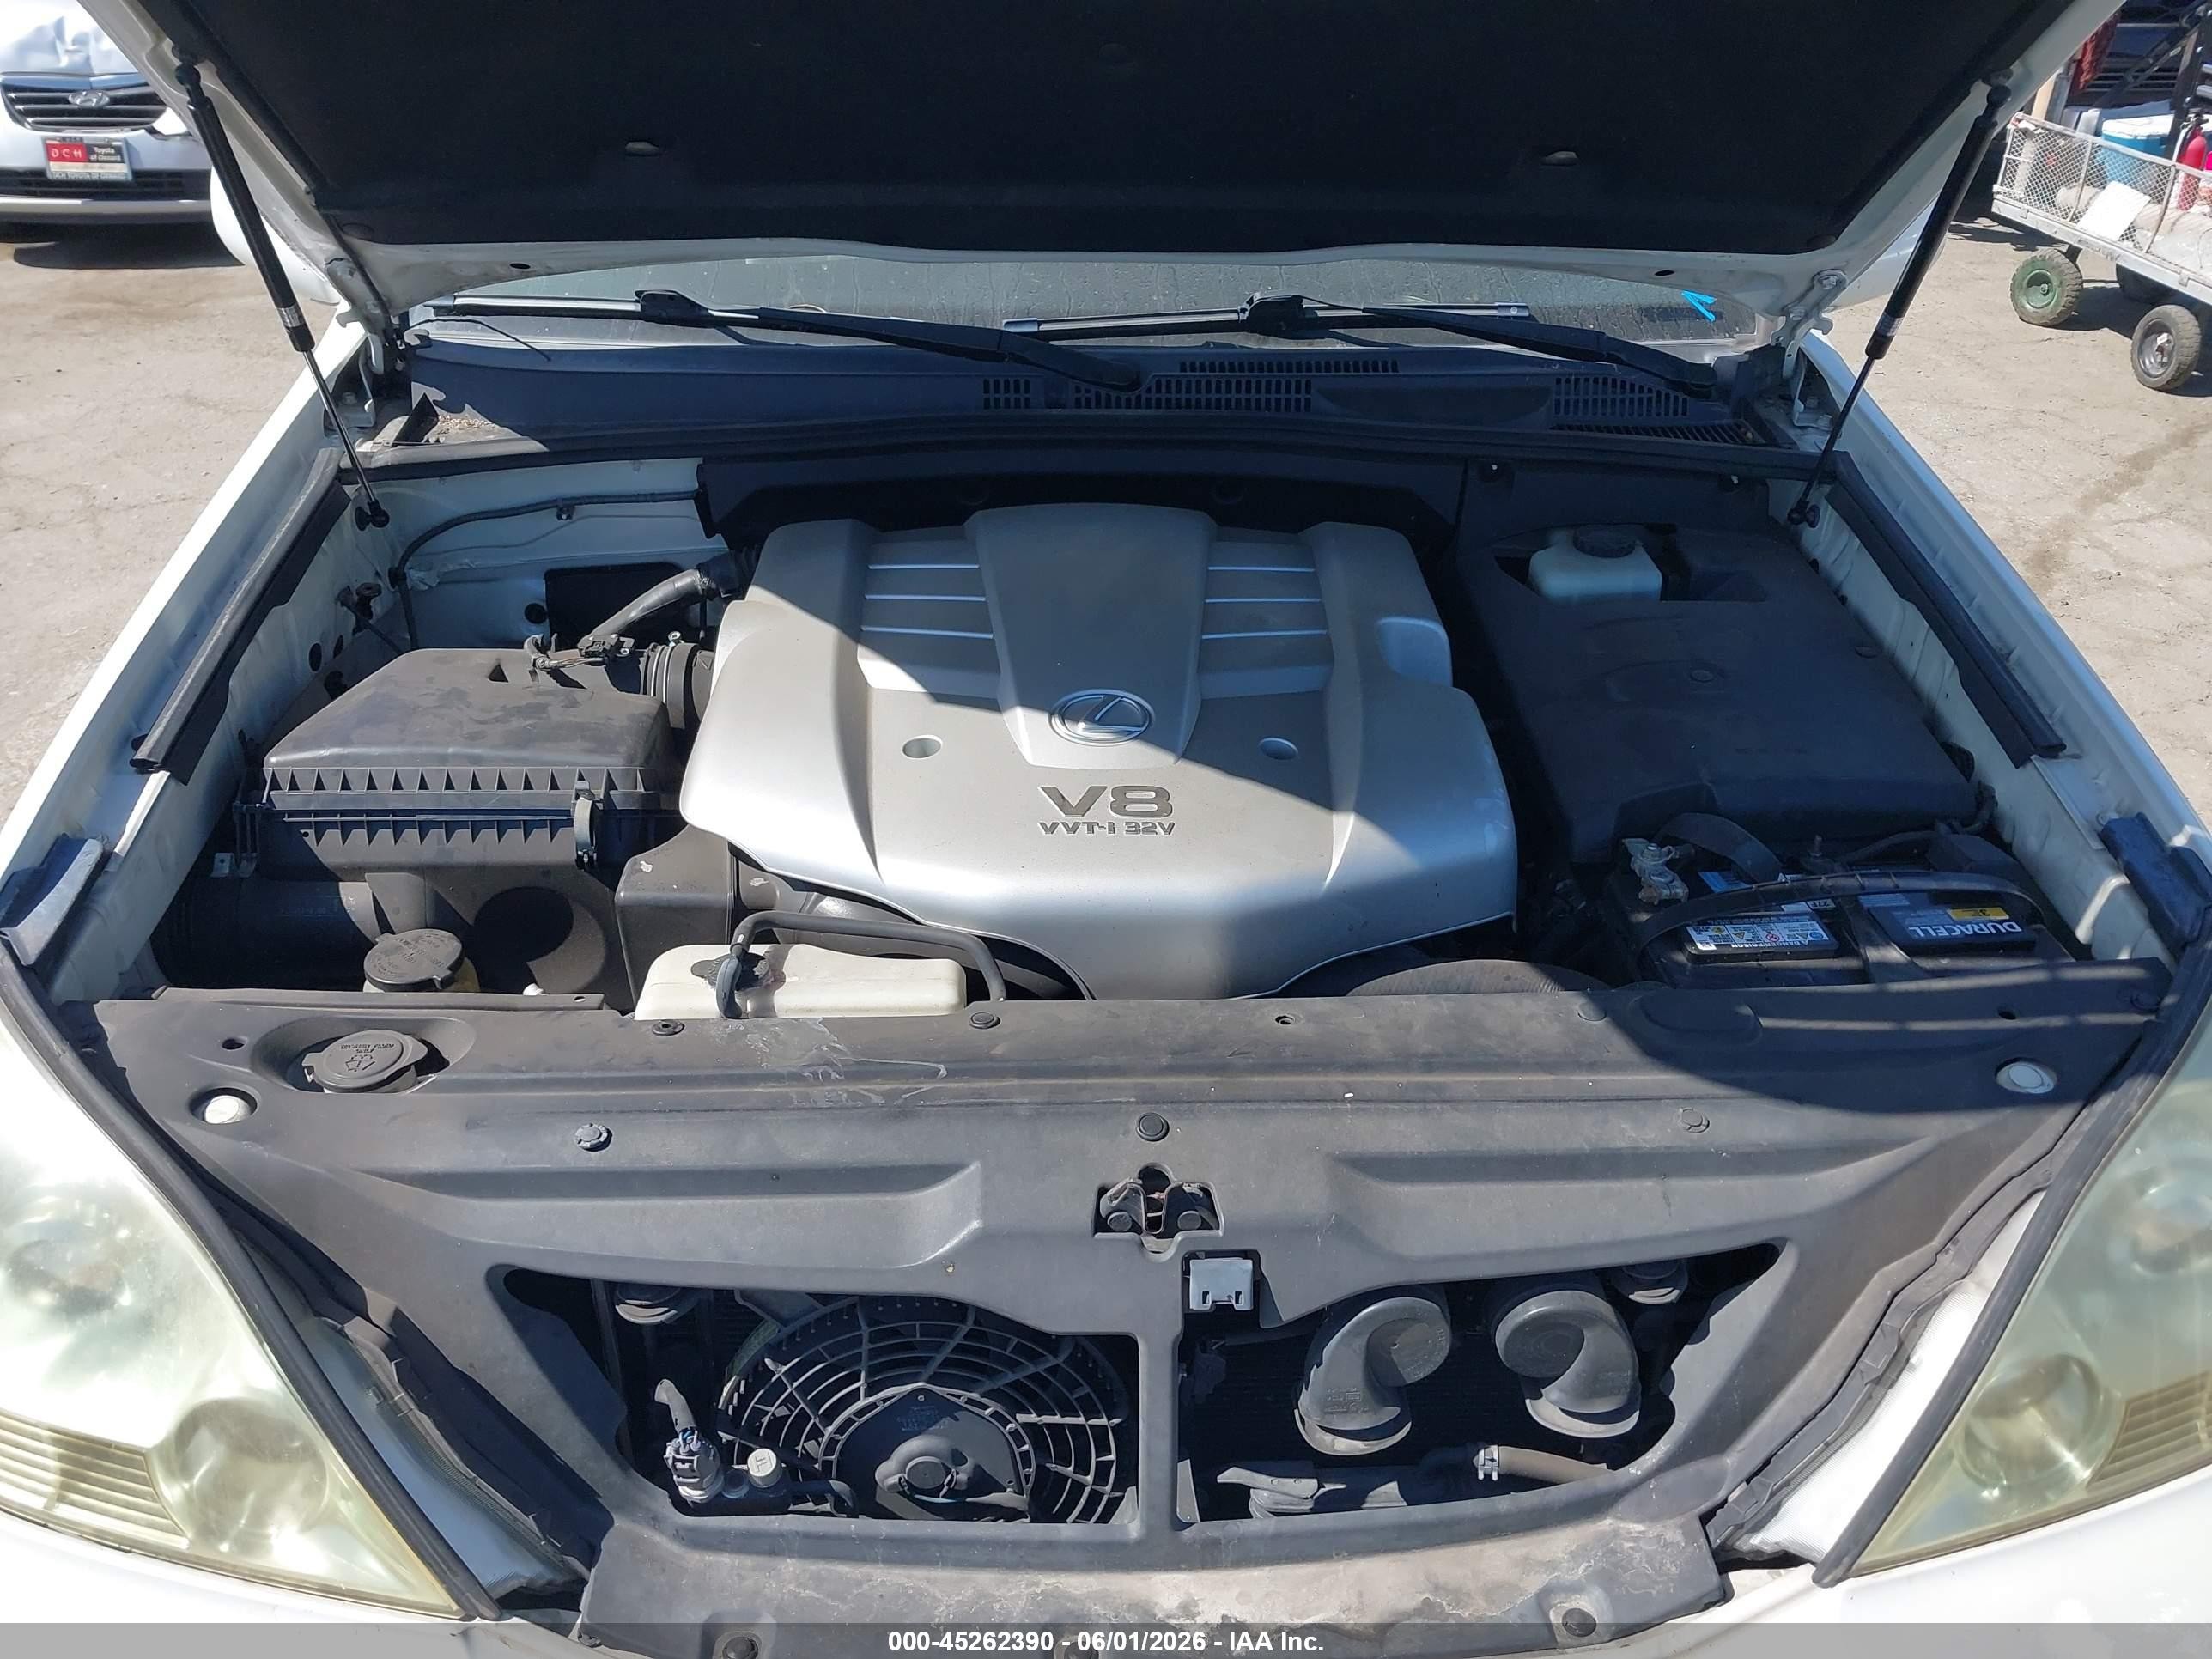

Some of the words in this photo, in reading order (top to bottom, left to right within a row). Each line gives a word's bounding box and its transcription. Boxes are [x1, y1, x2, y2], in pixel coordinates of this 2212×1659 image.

[1038, 785, 1173, 818] V8
[1125, 822, 1176, 836] 32V
[1908, 921, 2022, 938] DURACELL
